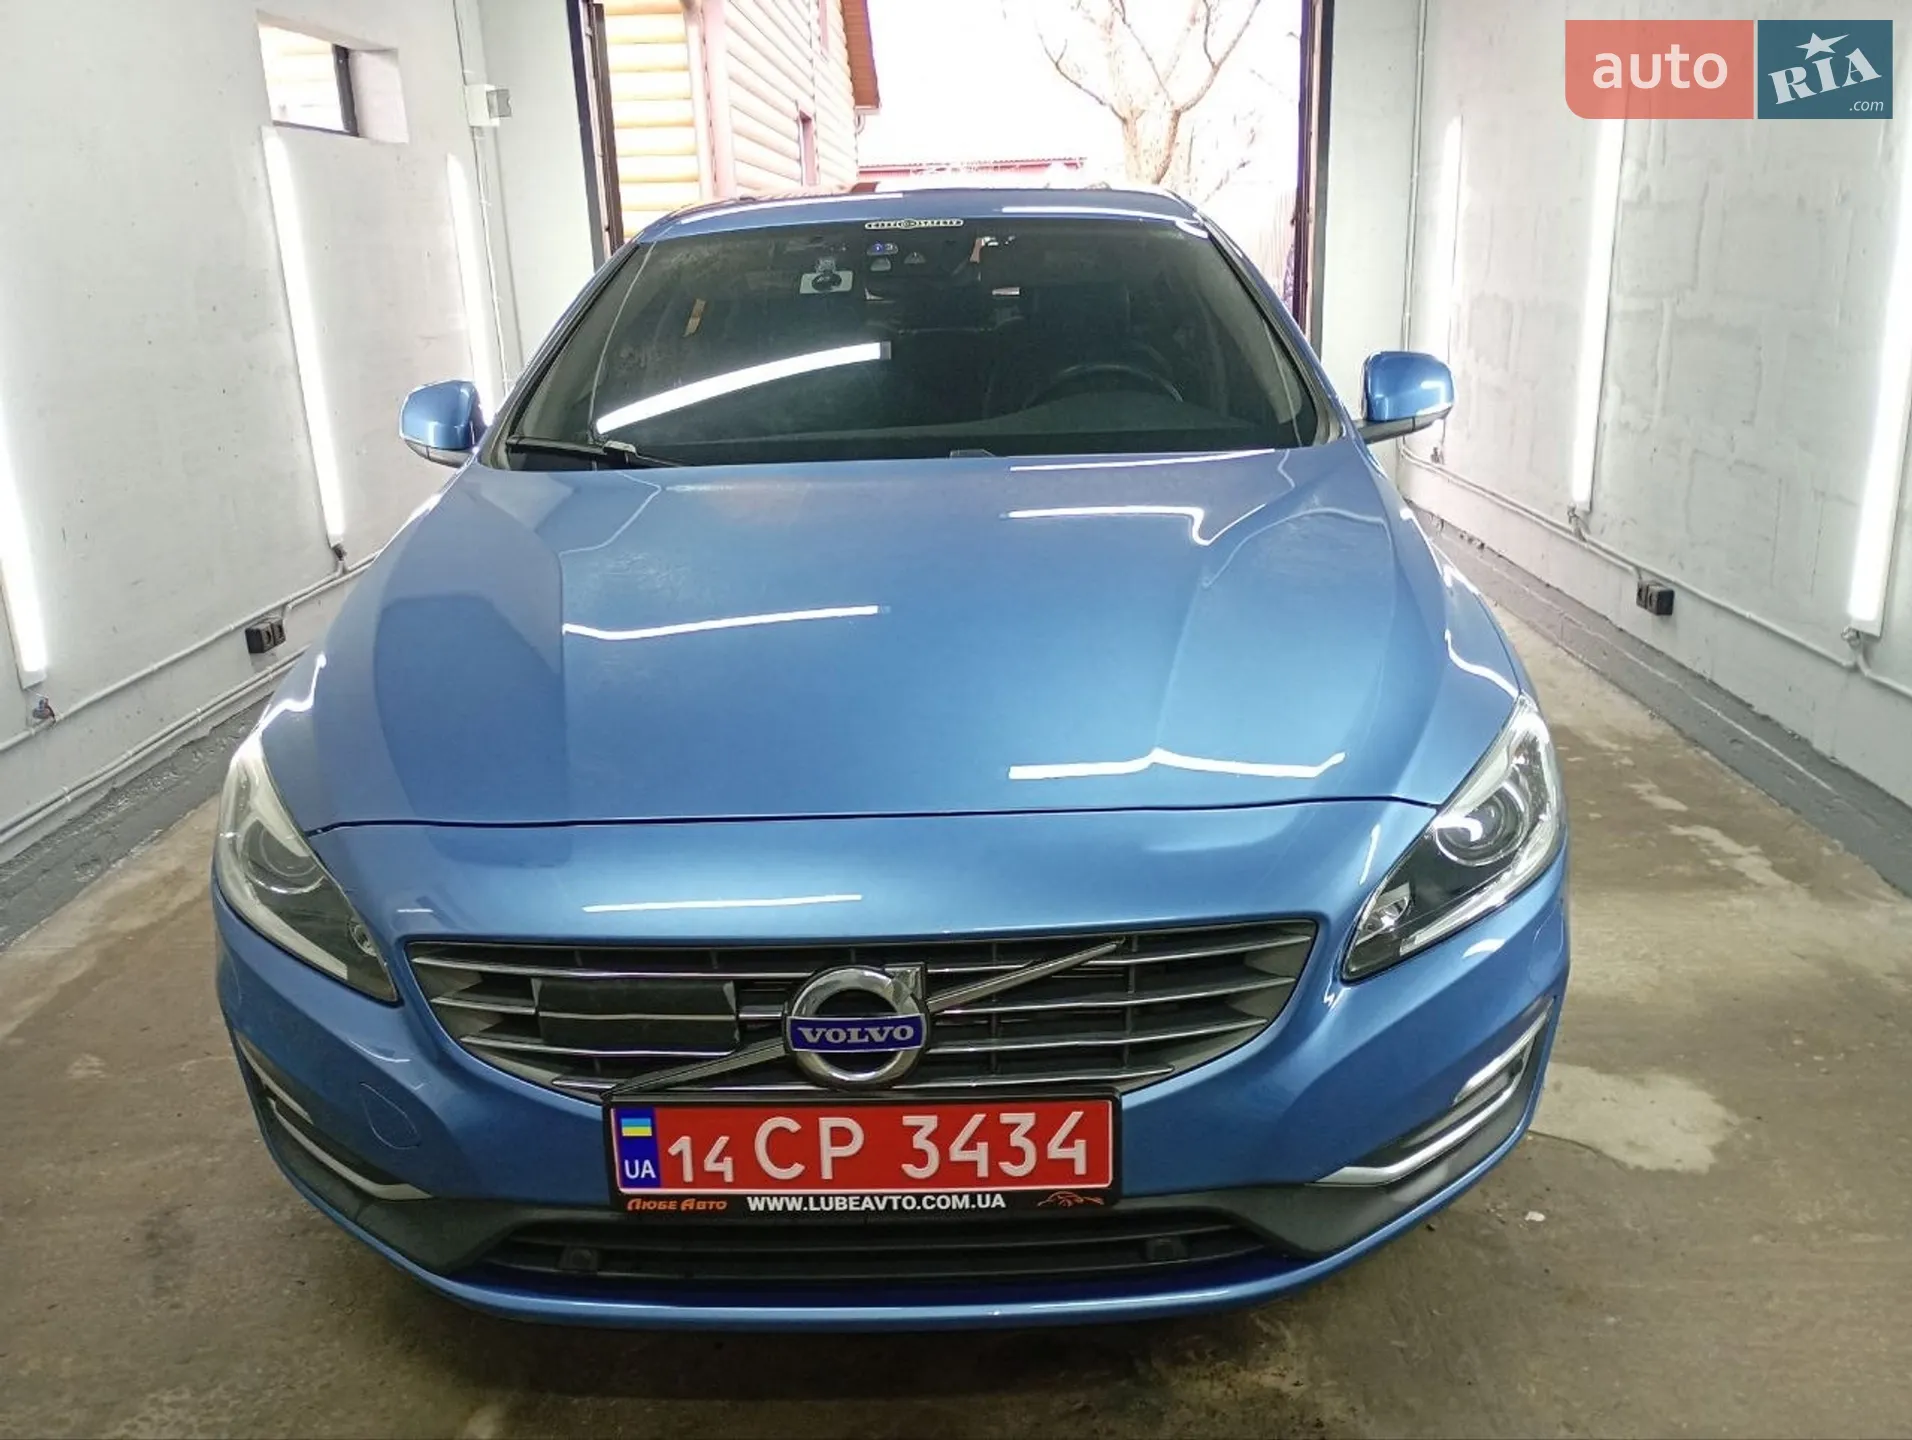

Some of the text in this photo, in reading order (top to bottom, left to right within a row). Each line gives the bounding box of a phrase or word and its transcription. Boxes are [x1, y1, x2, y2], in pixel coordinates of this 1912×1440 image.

[799, 1025, 914, 1043] VOLVO
[668, 1111, 1088, 1183] 14 CP 3434
[625, 1159, 656, 1179] UA
[747, 1194, 1006, 1212] WWW.LUBEAVTO.COM.UA
